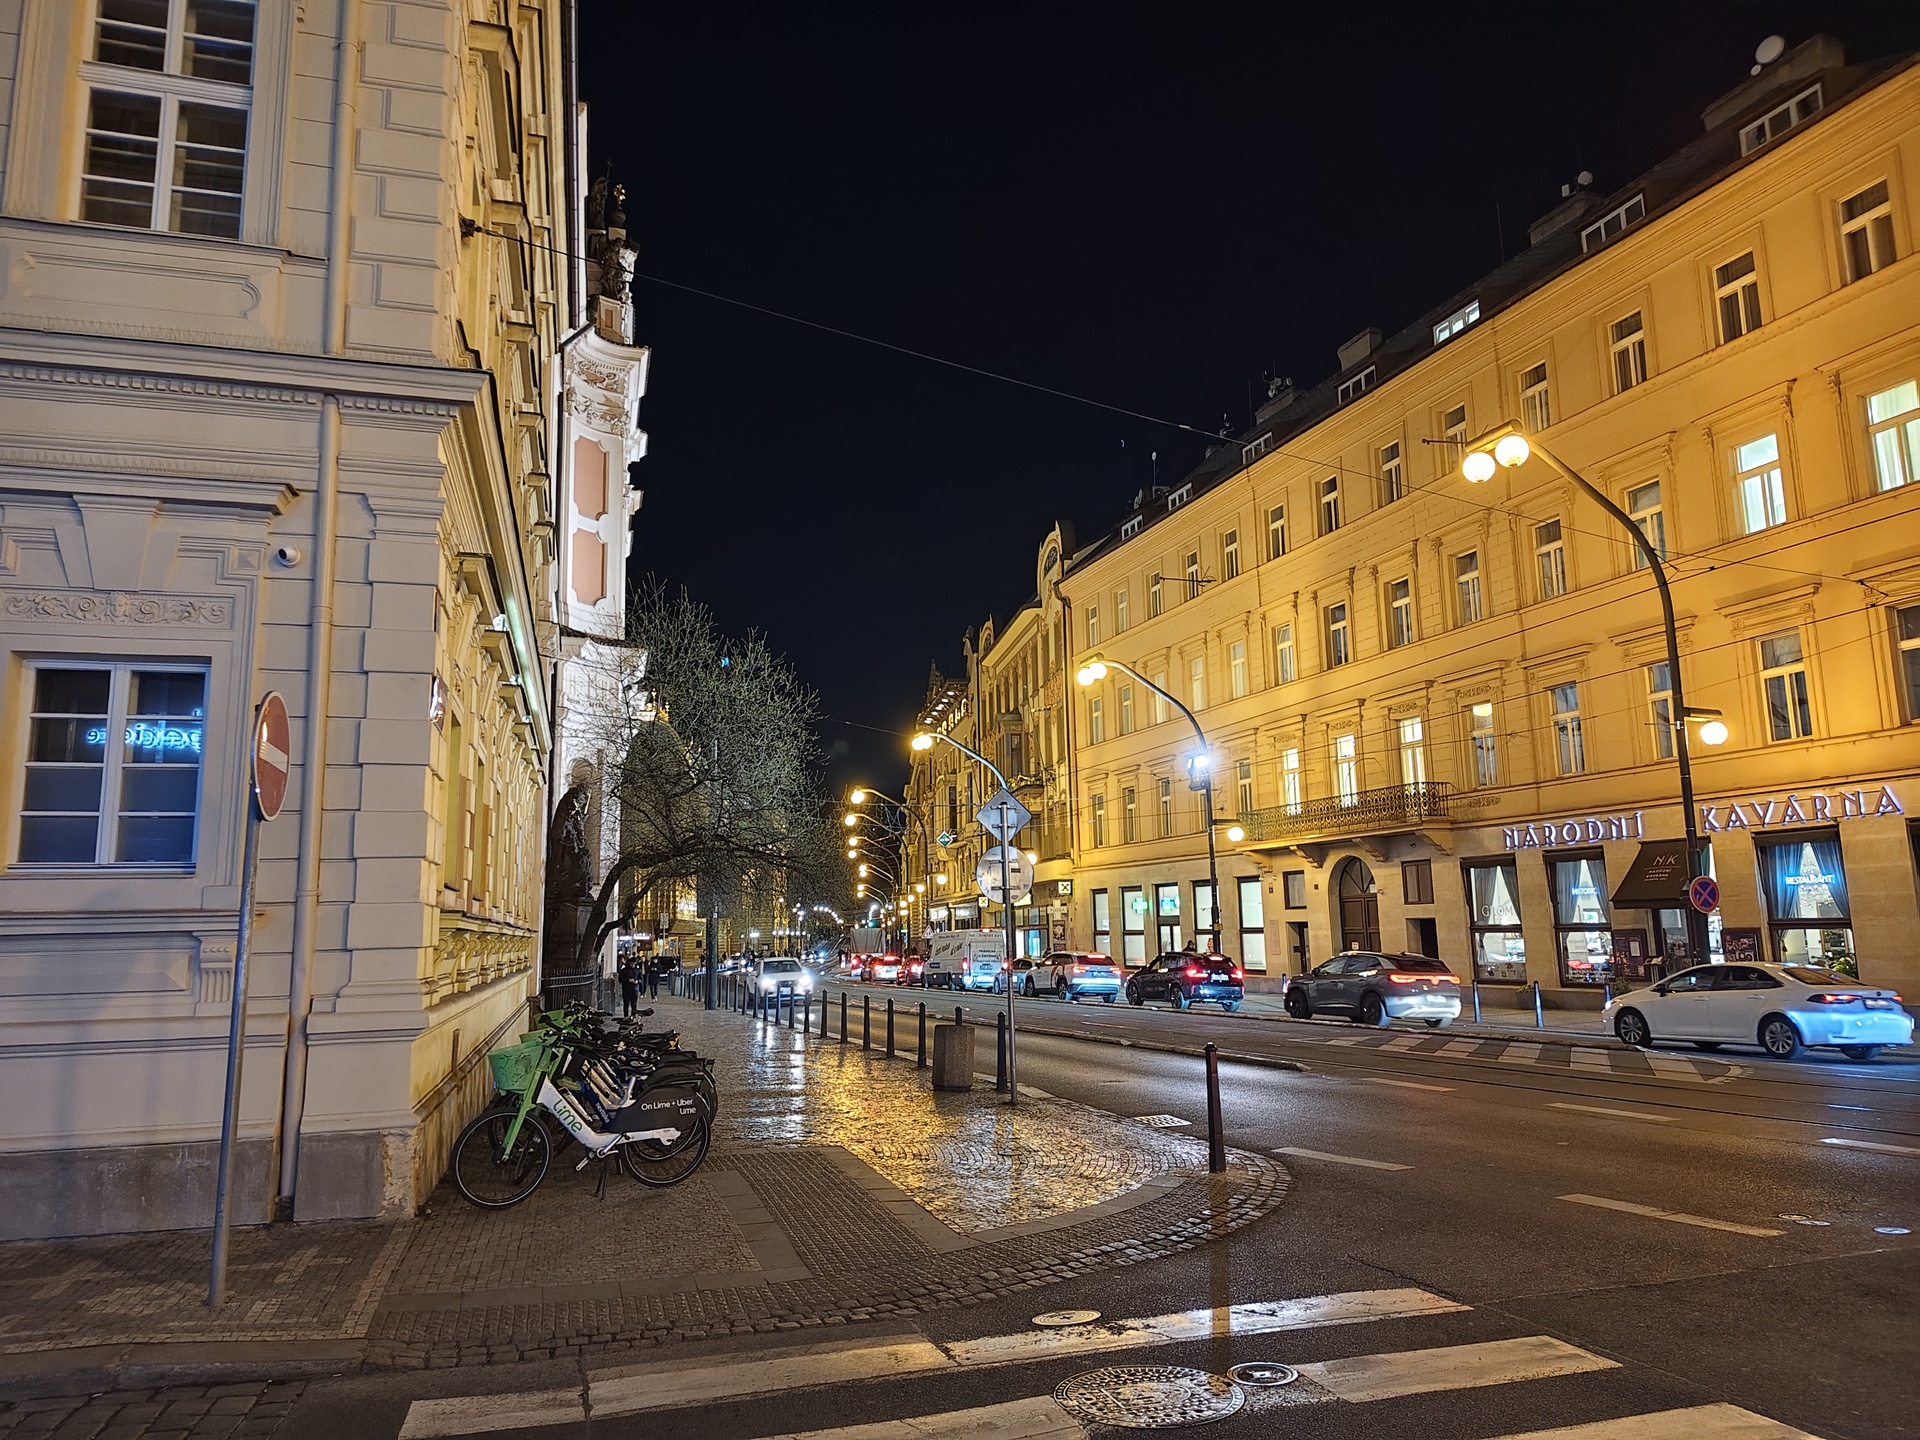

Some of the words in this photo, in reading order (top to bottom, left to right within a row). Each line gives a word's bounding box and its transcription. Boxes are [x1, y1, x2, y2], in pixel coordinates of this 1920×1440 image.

[1502, 810, 1643, 850] NÁRODNÍ
[1700, 785, 1905, 833] KAVÁRNA
[1785, 874, 1834, 885] RESTAURANT
[641, 1103, 653, 1111] On
[653, 1101, 671, 1109] Lime
[676, 1098, 694, 1106] Uber
